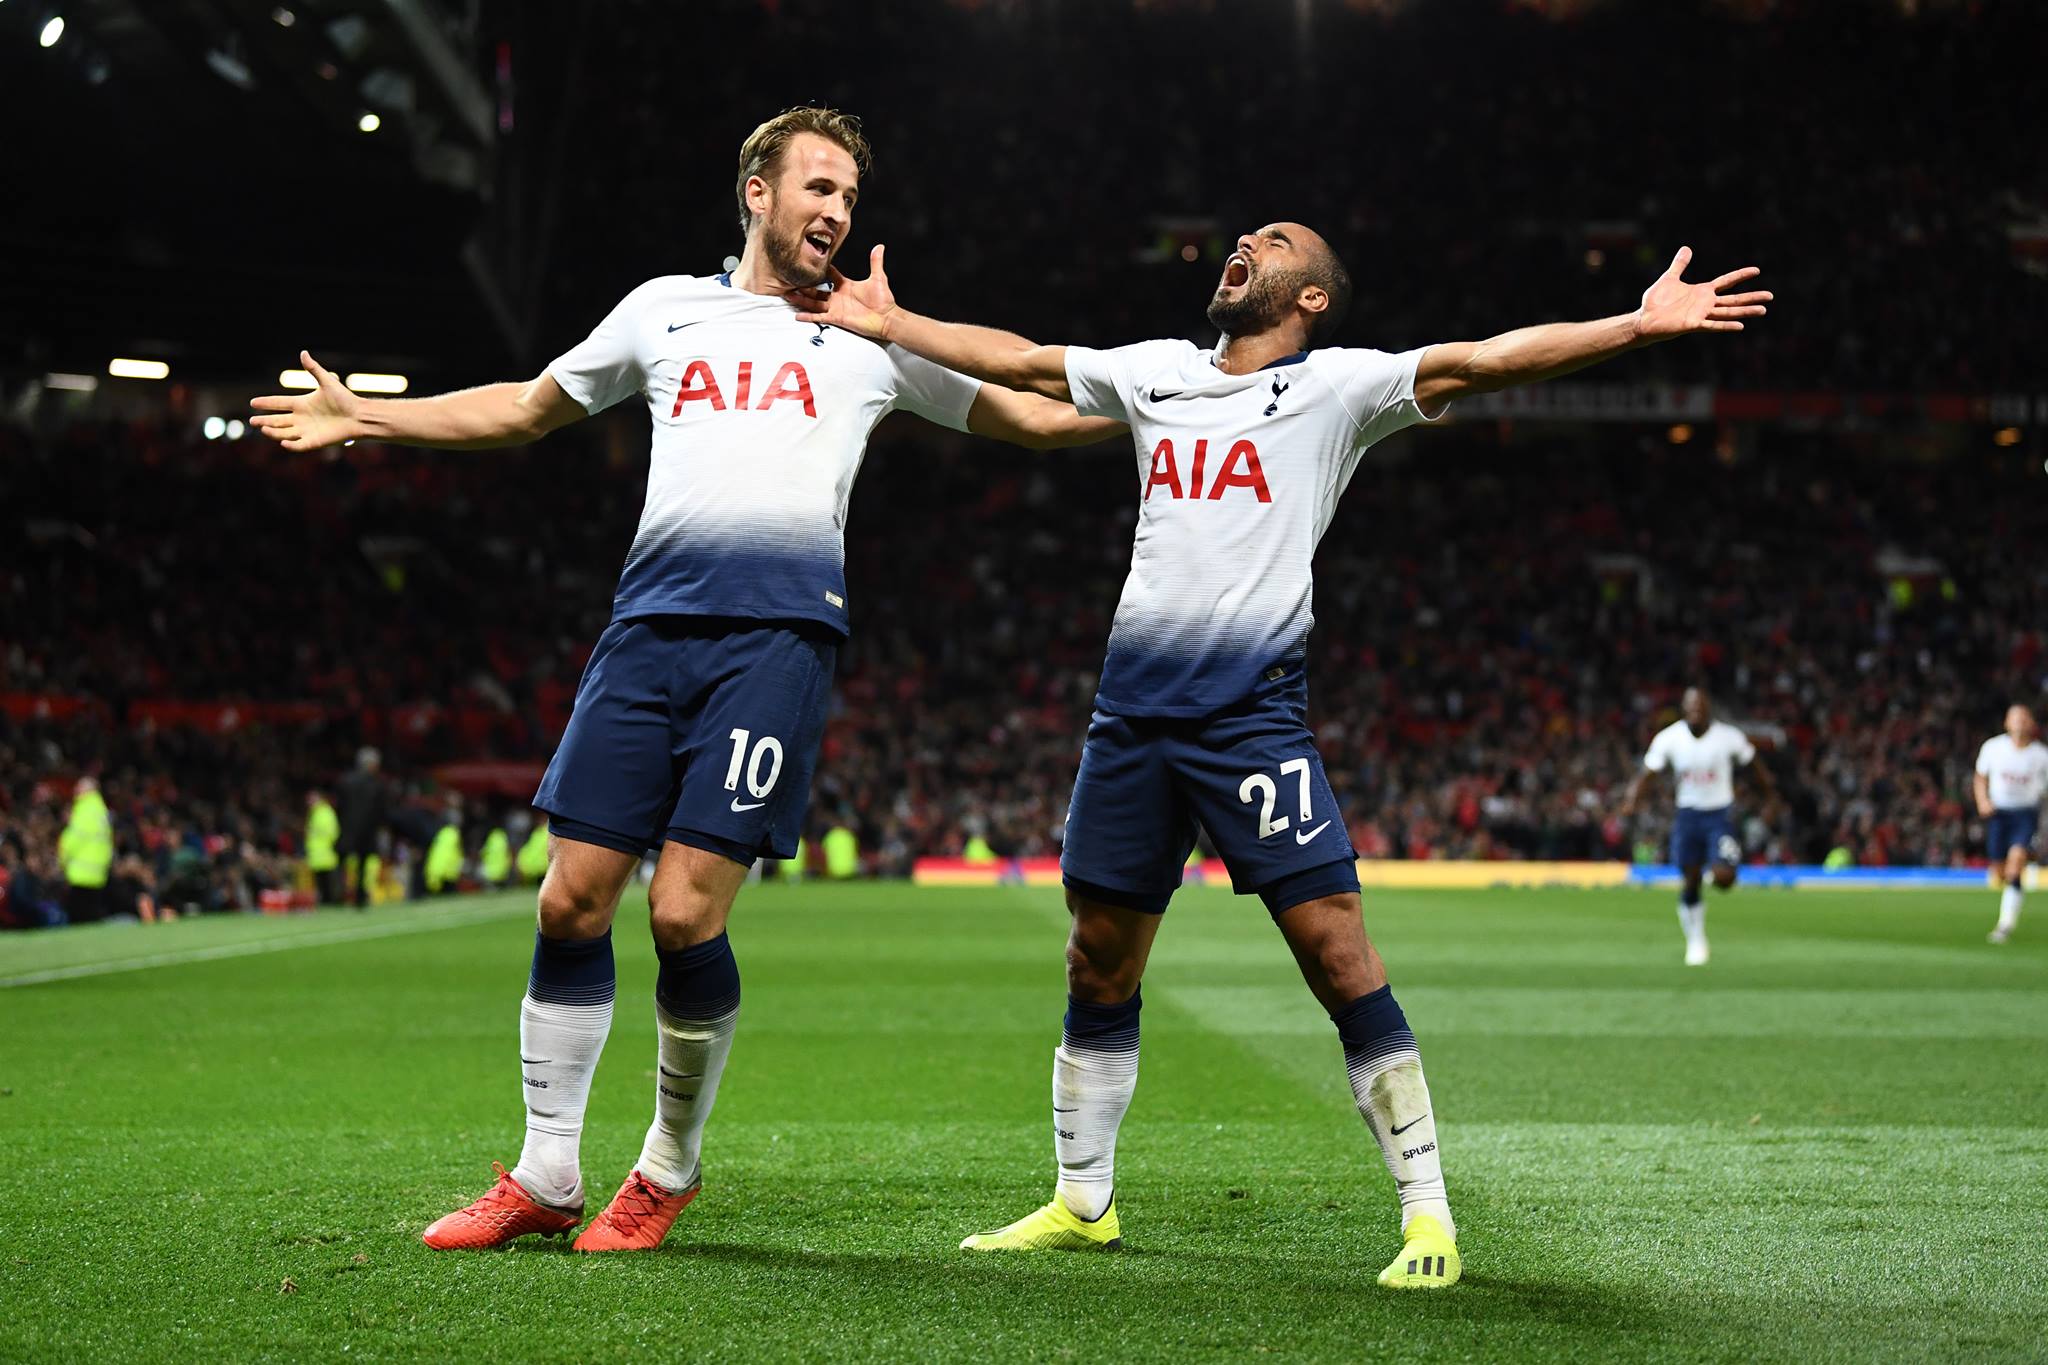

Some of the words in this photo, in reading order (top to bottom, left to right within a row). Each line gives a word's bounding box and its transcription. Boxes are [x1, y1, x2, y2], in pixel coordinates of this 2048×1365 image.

[672, 361, 817, 418] AIA
[1144, 438, 1273, 503] AIA
[724, 728, 784, 799] 10
[1239, 758, 1313, 840] 27
[1402, 1142, 1436, 1160] SPURS
